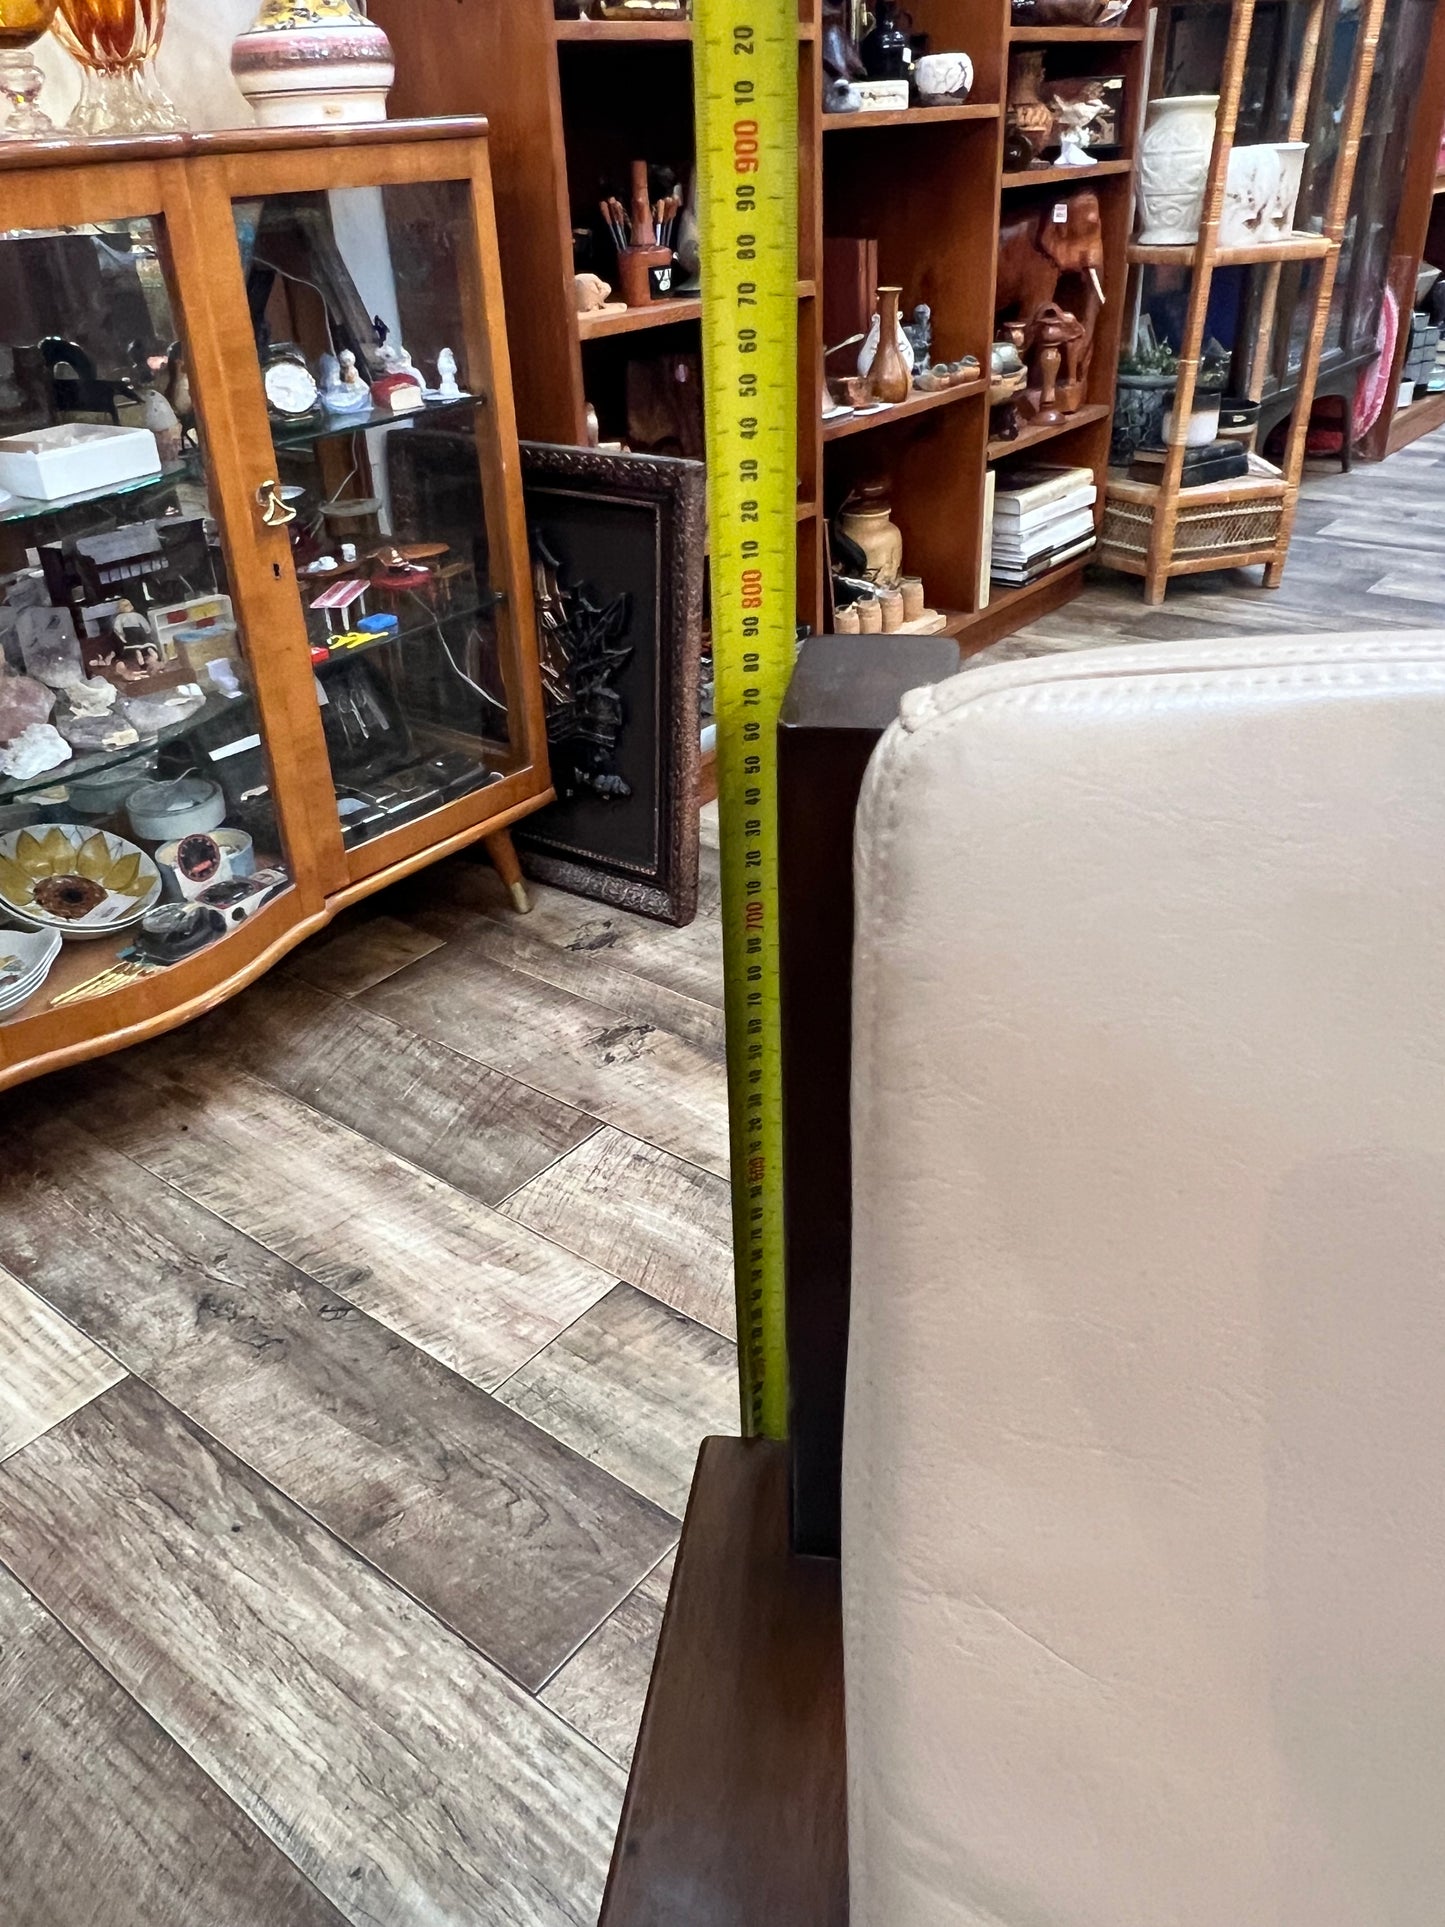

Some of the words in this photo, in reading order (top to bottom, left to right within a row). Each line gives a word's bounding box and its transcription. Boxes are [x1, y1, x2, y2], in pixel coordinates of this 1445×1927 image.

[733, 25, 754, 55] 20
[734, 80, 754, 105] 10
[733, 119, 758, 173] 900
[736, 185, 755, 211] 90
[736, 234, 756, 260] 80
[737, 282, 757, 308] 70
[737, 329, 757, 353] 60
[738, 373, 757, 397] 50
[738, 417, 758, 440] 40
[739, 459, 758, 482] 30
[740, 500, 758, 522] 20
[741, 541, 758, 559] 10
[741, 569, 762, 609] 800
[742, 616, 759, 637] 90
[743, 653, 759, 672] 80
[743, 688, 760, 706] 70
[743, 722, 760, 741] 60
[744, 755, 760, 774] 50
[745, 850, 761, 868] 20
[745, 881, 761, 896] 10
